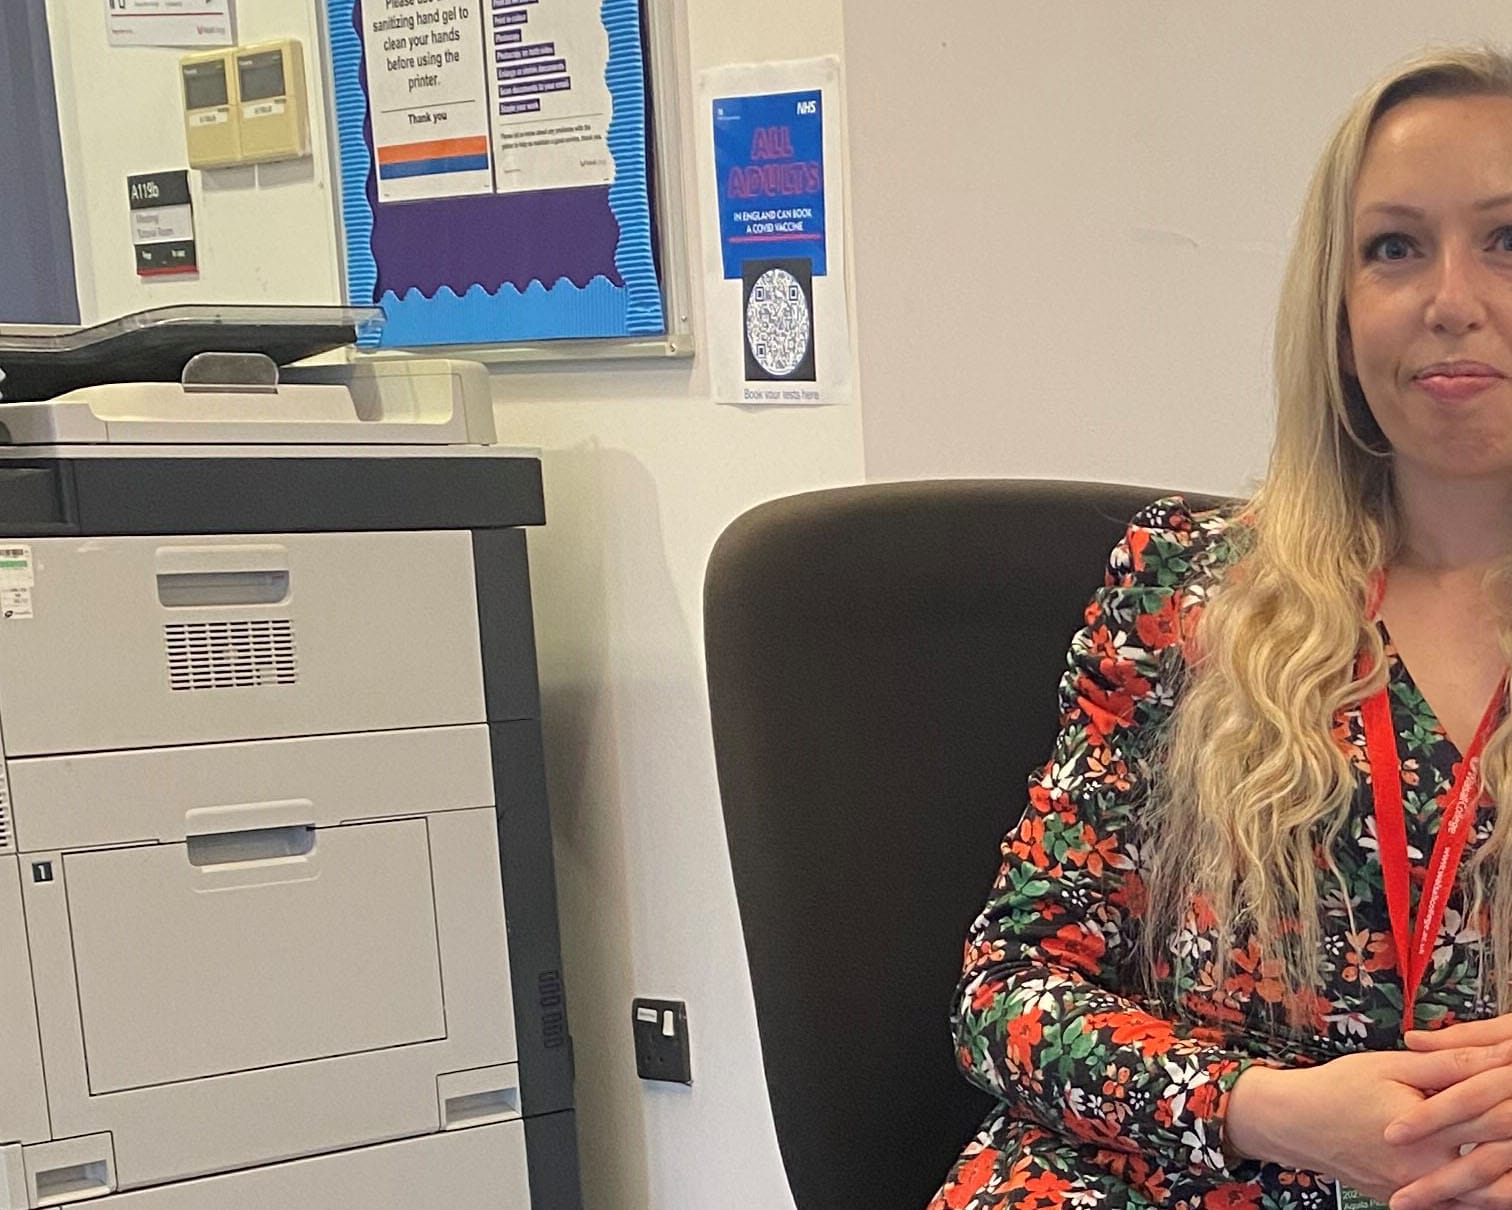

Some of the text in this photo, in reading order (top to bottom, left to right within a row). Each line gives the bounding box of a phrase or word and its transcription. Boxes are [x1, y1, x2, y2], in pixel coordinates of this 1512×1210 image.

[373, 6, 469, 32] sanitizing hand gel to
[384, 27, 461, 51] clean your hands
[387, 49, 460, 71] before using the
[408, 74, 441, 93] printer.
[408, 112, 448, 124] Thank you
[797, 101, 817, 115] NHS
[752, 127, 794, 159] ALL
[728, 162, 820, 198] ADULTS
[733, 208, 812, 222] IN ENGLAND CAN BOOK
[746, 221, 804, 234] A COVID VACCINE
[1448, 800, 1469, 835] College
[38, 864, 46, 880] 1
